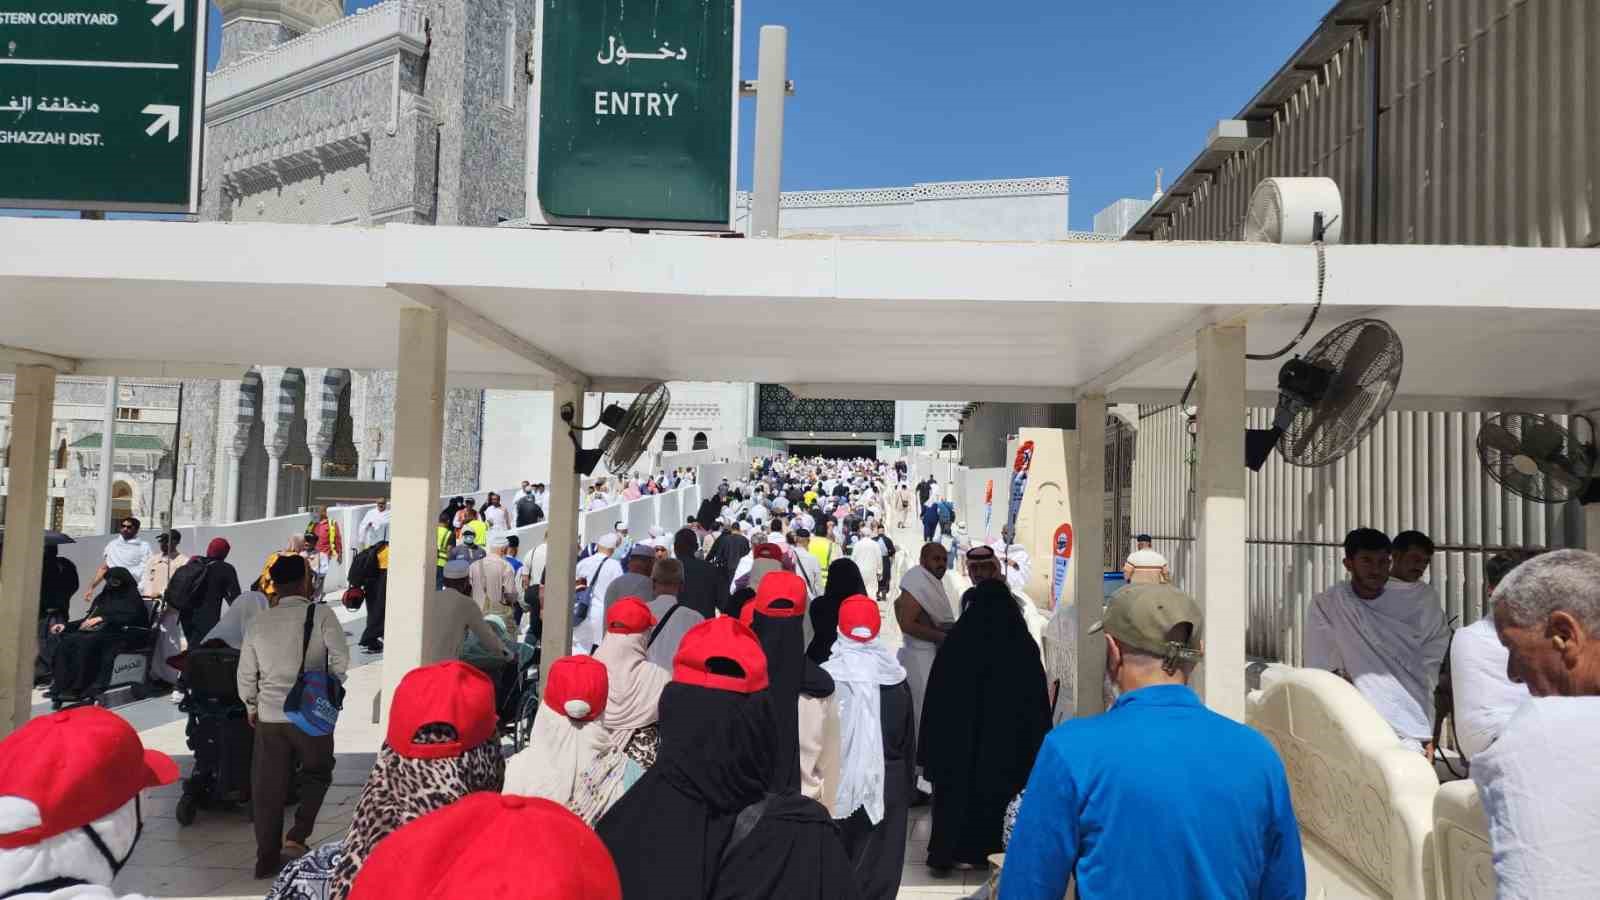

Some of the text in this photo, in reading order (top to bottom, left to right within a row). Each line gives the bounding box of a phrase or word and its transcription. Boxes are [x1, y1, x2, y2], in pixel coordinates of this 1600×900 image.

[39, 12, 119, 26] COURTYARD
[596, 35, 688, 65] دخول
[36, 96, 100, 114] منطقة
[594, 90, 679, 117] ENTRY
[0, 130, 105, 146] GHAZZAH DIST.
